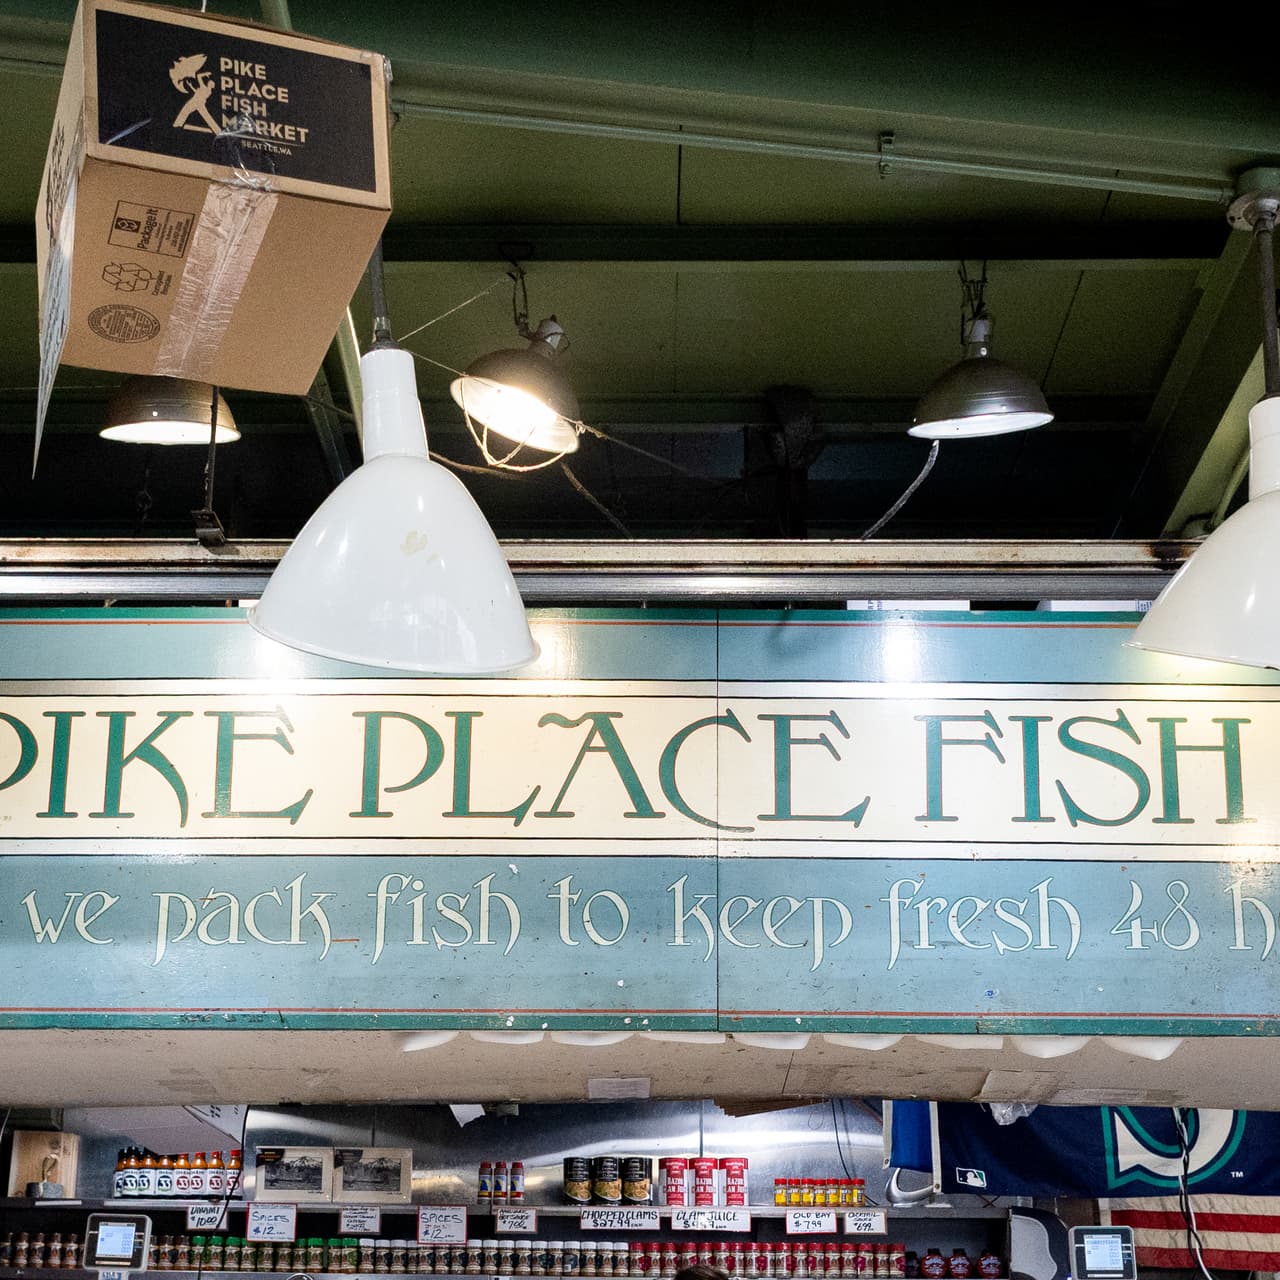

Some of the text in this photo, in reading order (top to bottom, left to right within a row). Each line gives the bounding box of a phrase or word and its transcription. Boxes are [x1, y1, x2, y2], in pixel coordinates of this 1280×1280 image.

[220, 57, 267, 80] PIKE
[220, 77, 289, 104] PLACE
[221, 96, 267, 117] FISH
[222, 116, 309, 143] MARKET
[137, 215, 159, 250] Package
[349, 707, 871, 832] PLACE
[914, 707, 1257, 828] FISH
[21, 885, 120, 946] we
[152, 873, 334, 966] pack
[367, 871, 522, 966] fish
[546, 873, 631, 947] to
[665, 873, 855, 972] keep
[879, 876, 1082, 971] fresh
[1118, 879, 1201, 952] 48
[251, 1211, 291, 1223] SPICES
[421, 1212, 464, 1224] SPICES
[582, 1209, 658, 1221] CHOPPED CLAMS
[676, 1210, 739, 1222] CLAM JUICE
